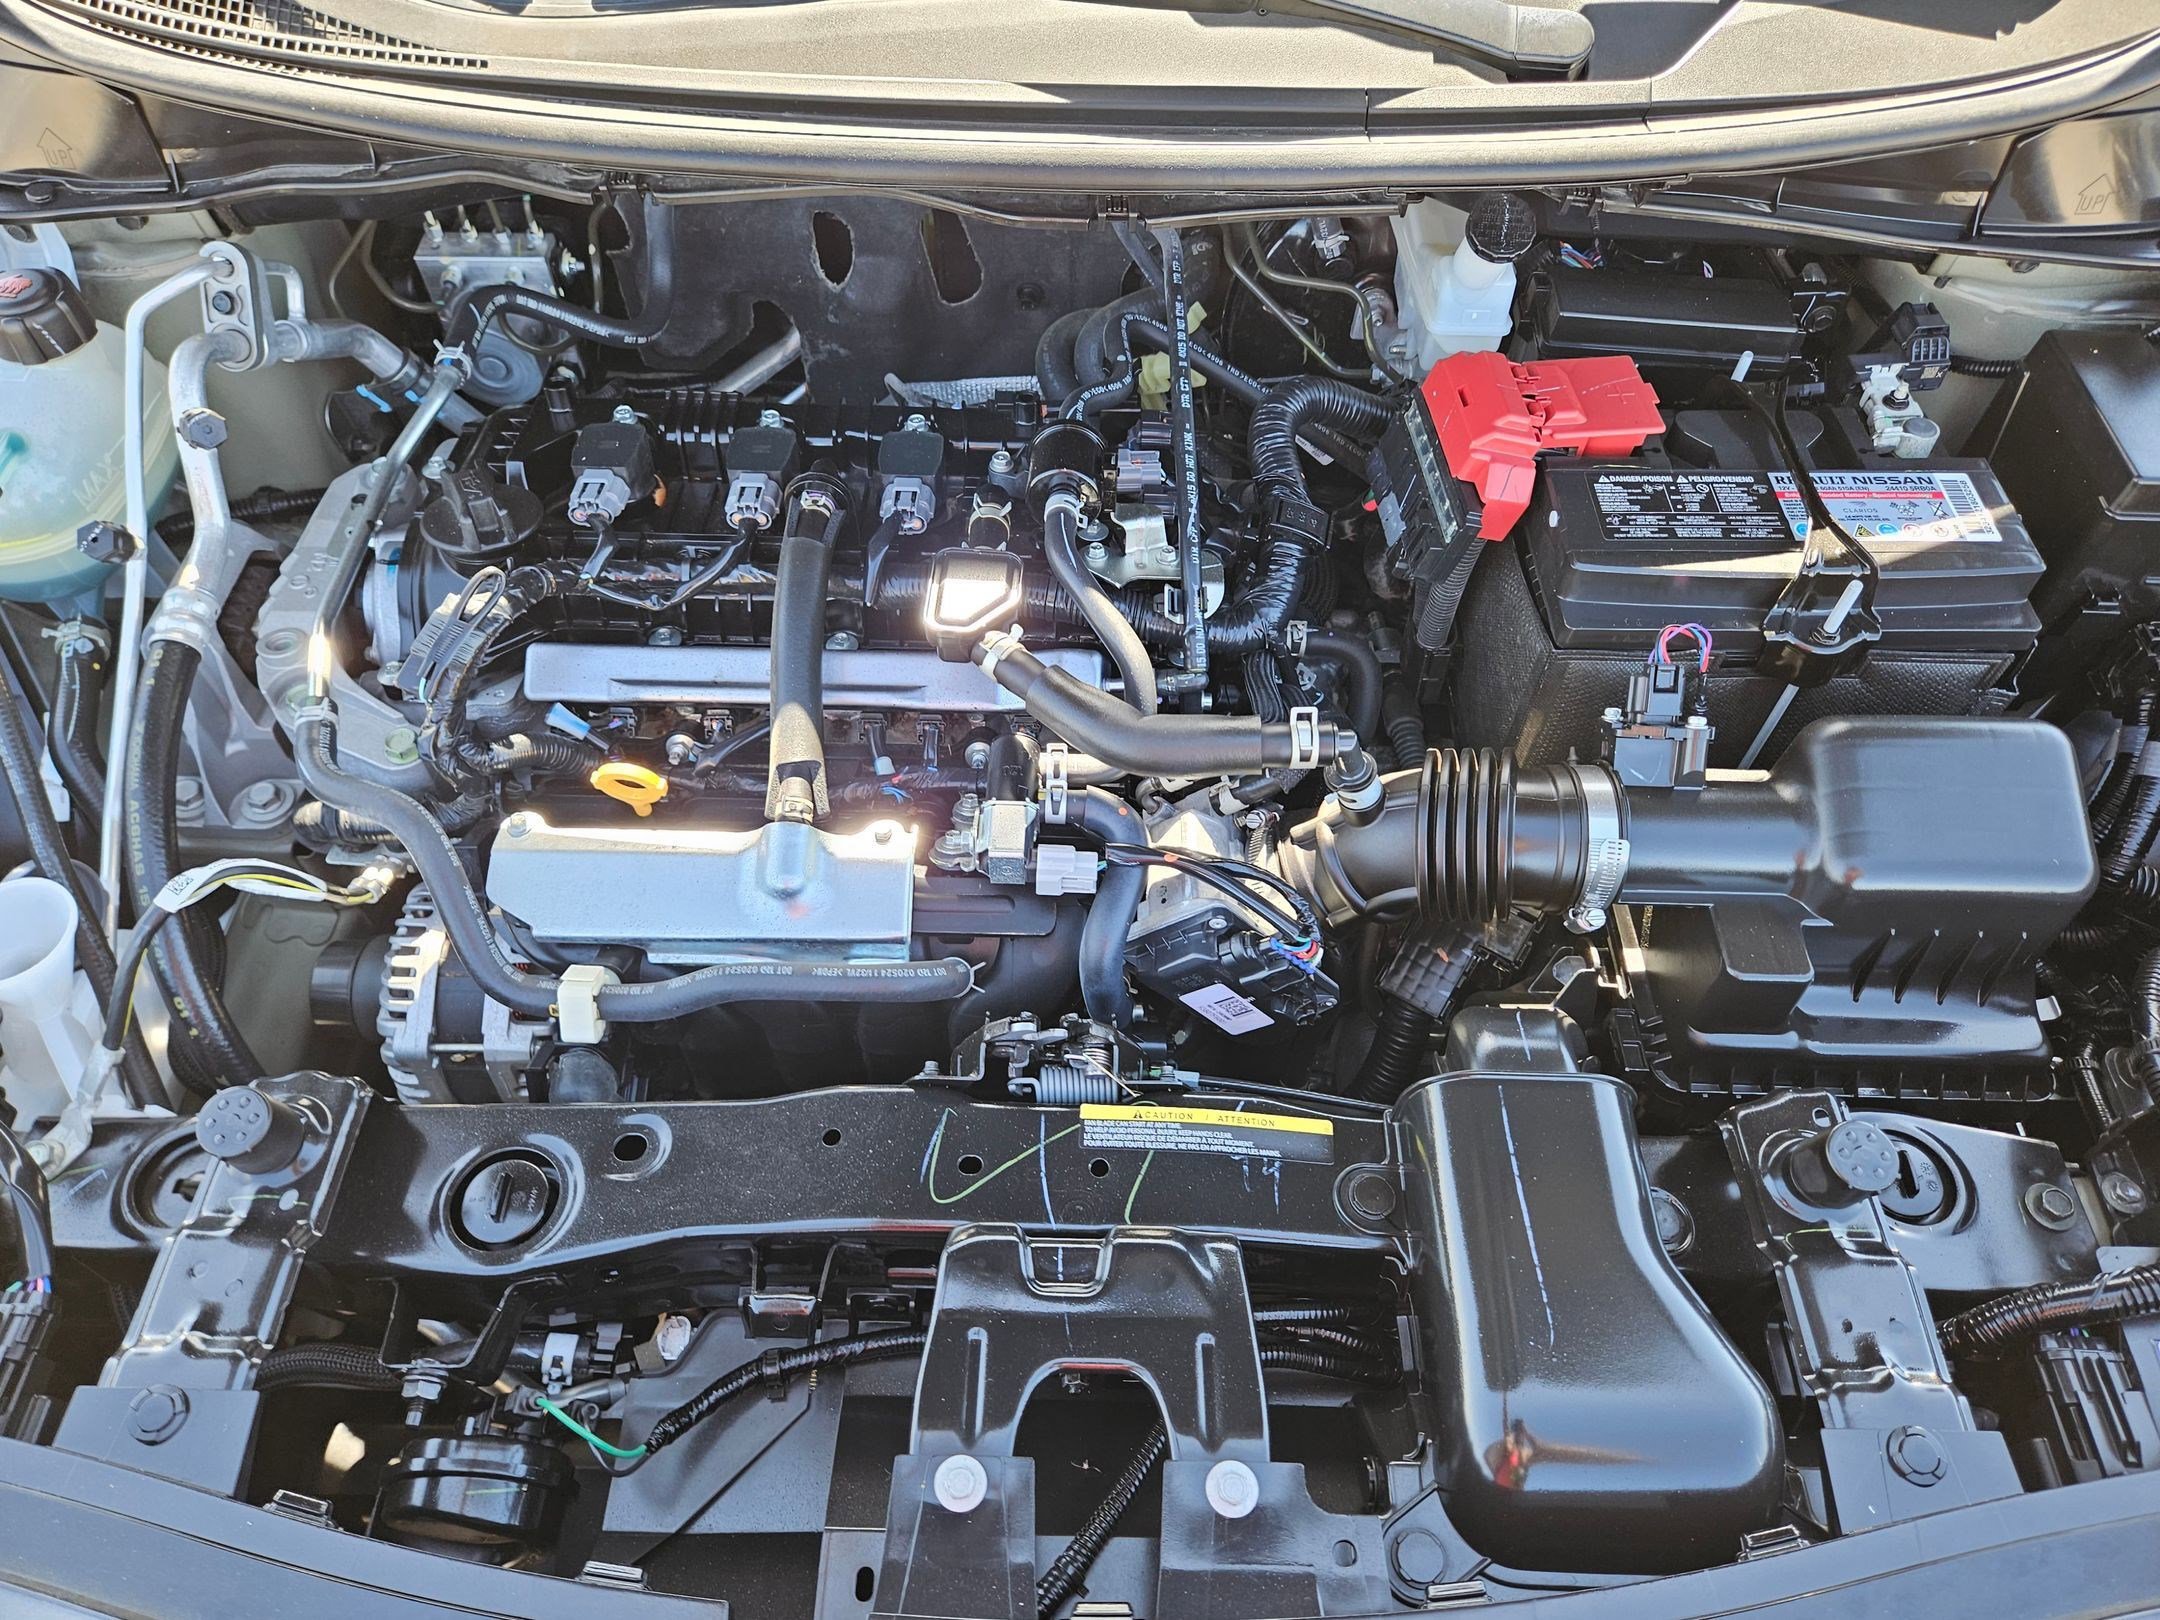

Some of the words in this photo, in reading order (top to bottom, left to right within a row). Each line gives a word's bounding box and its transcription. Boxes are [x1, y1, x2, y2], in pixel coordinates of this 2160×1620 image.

[46, 149, 68, 167] UP
[2080, 194, 2104, 211] UP
[1853, 476, 1934, 485] NISSAN
[1145, 1111, 1193, 1120] CAUTION
[1217, 1115, 1275, 1127] ATTENTION
[1092, 1133, 1133, 1141] VENTILATEUR
[1134, 1134, 1157, 1142] RISQUE
[1124, 1141, 1145, 1149] TOUTE
[1210, 1145, 1247, 1154] APPROCHER
